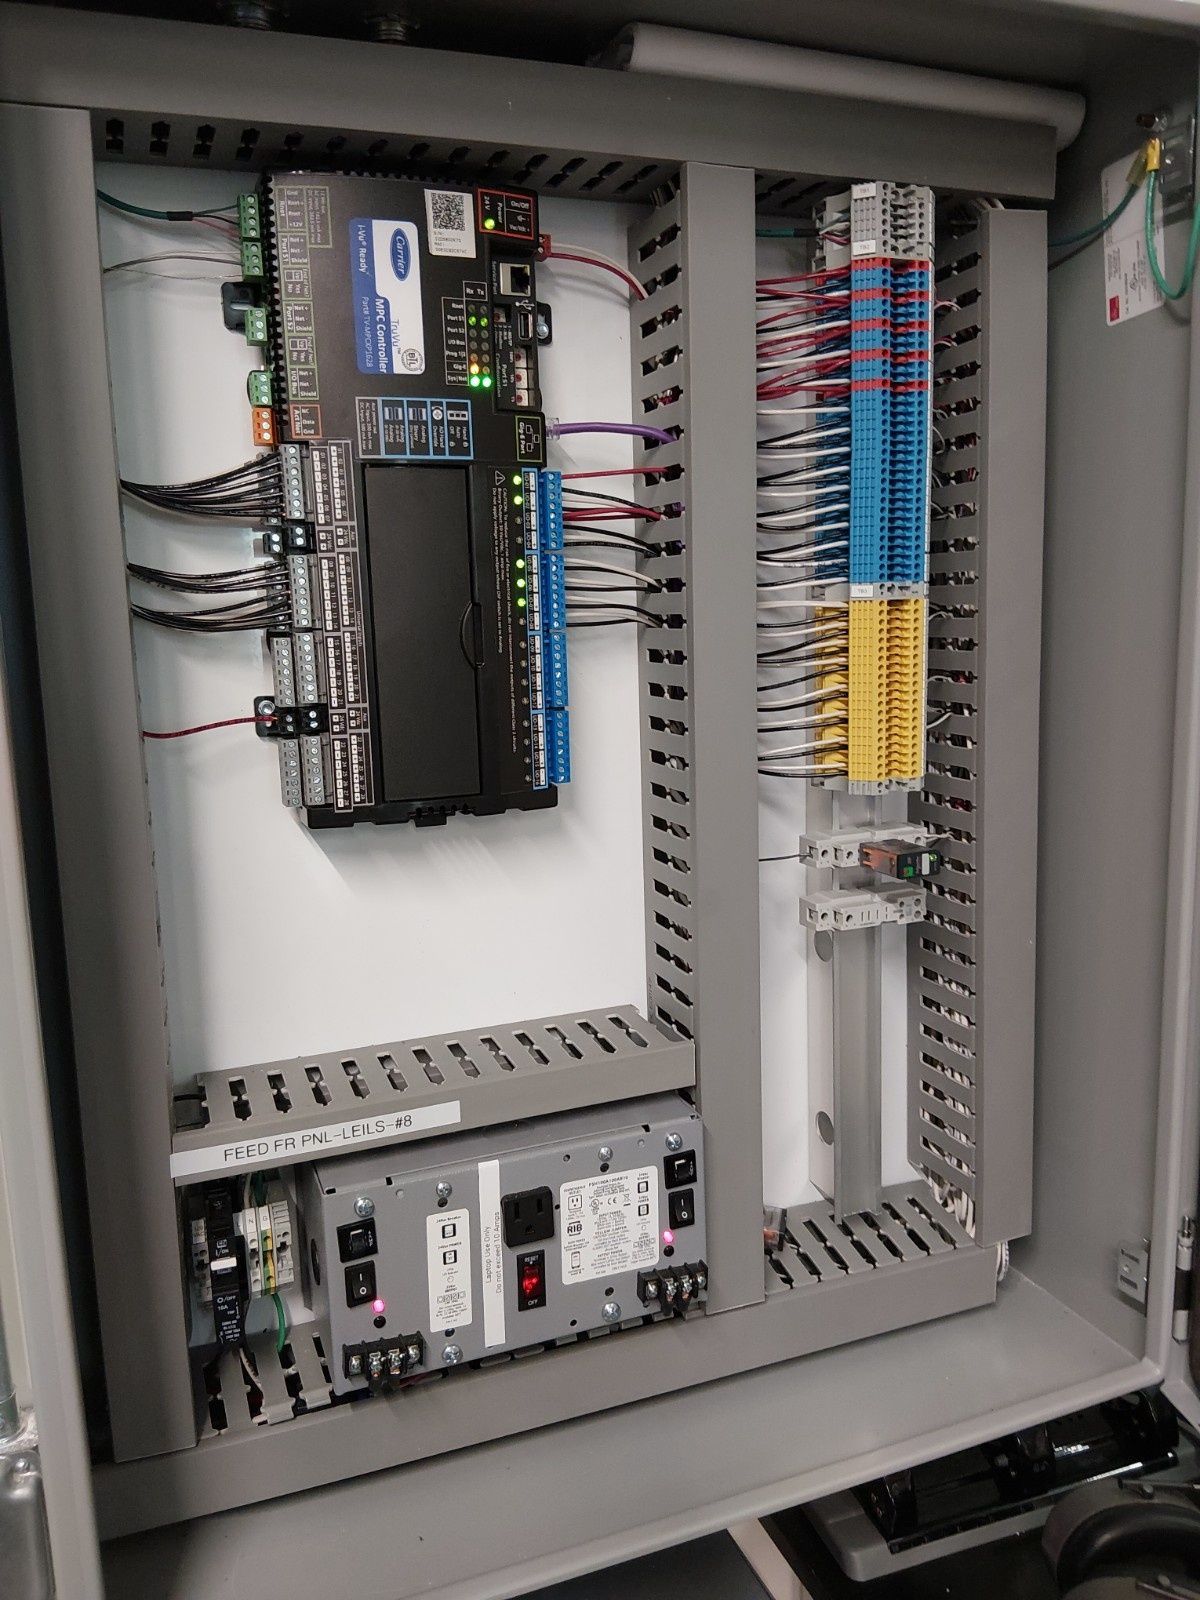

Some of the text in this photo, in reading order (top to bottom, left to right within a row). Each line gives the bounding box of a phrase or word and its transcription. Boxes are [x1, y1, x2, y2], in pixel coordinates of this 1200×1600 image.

[359, 248, 367, 274] Ready
[395, 236, 406, 275] Carrier
[375, 299, 388, 373] MPC Controller
[224, 1114, 412, 1162] FEED FR PNL-LEILS-#8
[494, 1234, 500, 1243] 10
[567, 1224, 582, 1234] RIB
[496, 1284, 501, 1294] Do
